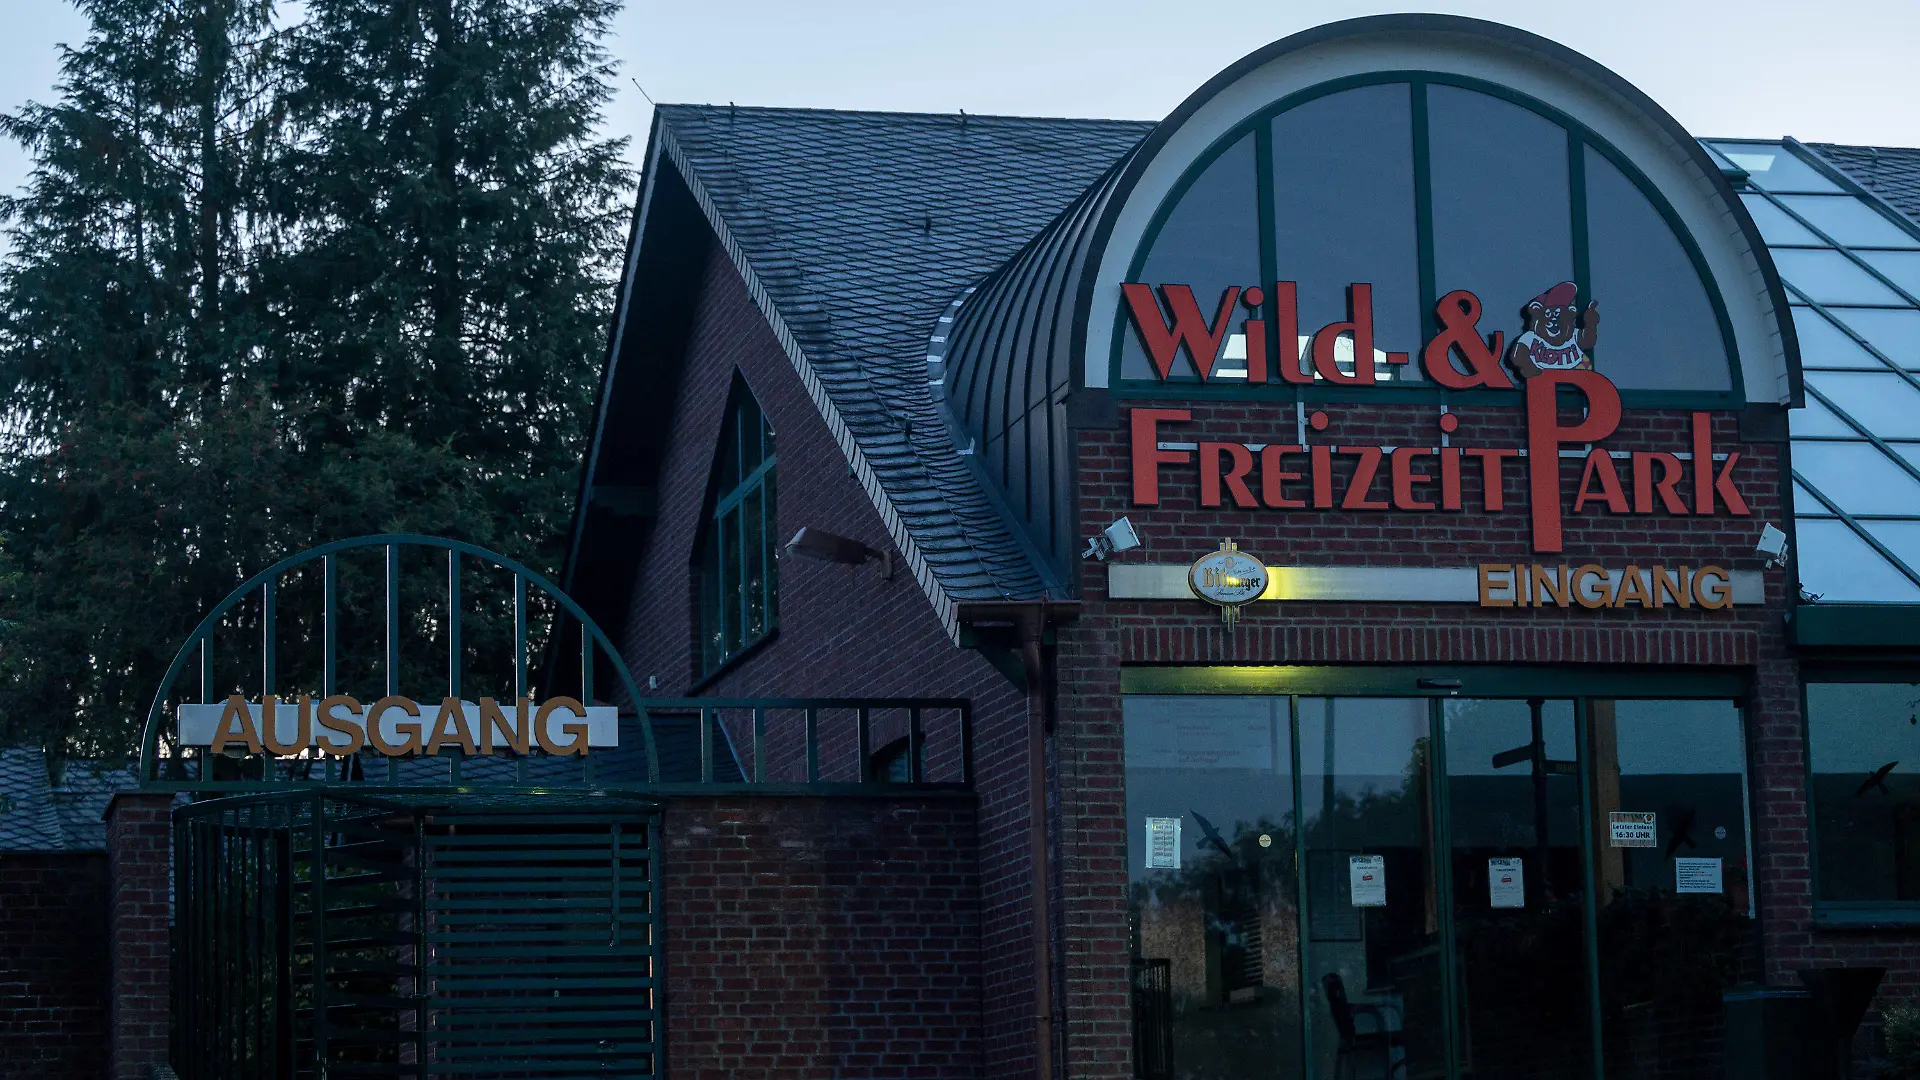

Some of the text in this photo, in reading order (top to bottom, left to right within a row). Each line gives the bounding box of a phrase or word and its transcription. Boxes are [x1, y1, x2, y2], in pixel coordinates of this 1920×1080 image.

[1120, 281, 1514, 389] Wild- &
[1478, 563, 1734, 610] EINGANG
[210, 694, 589, 756] AUSGANG
